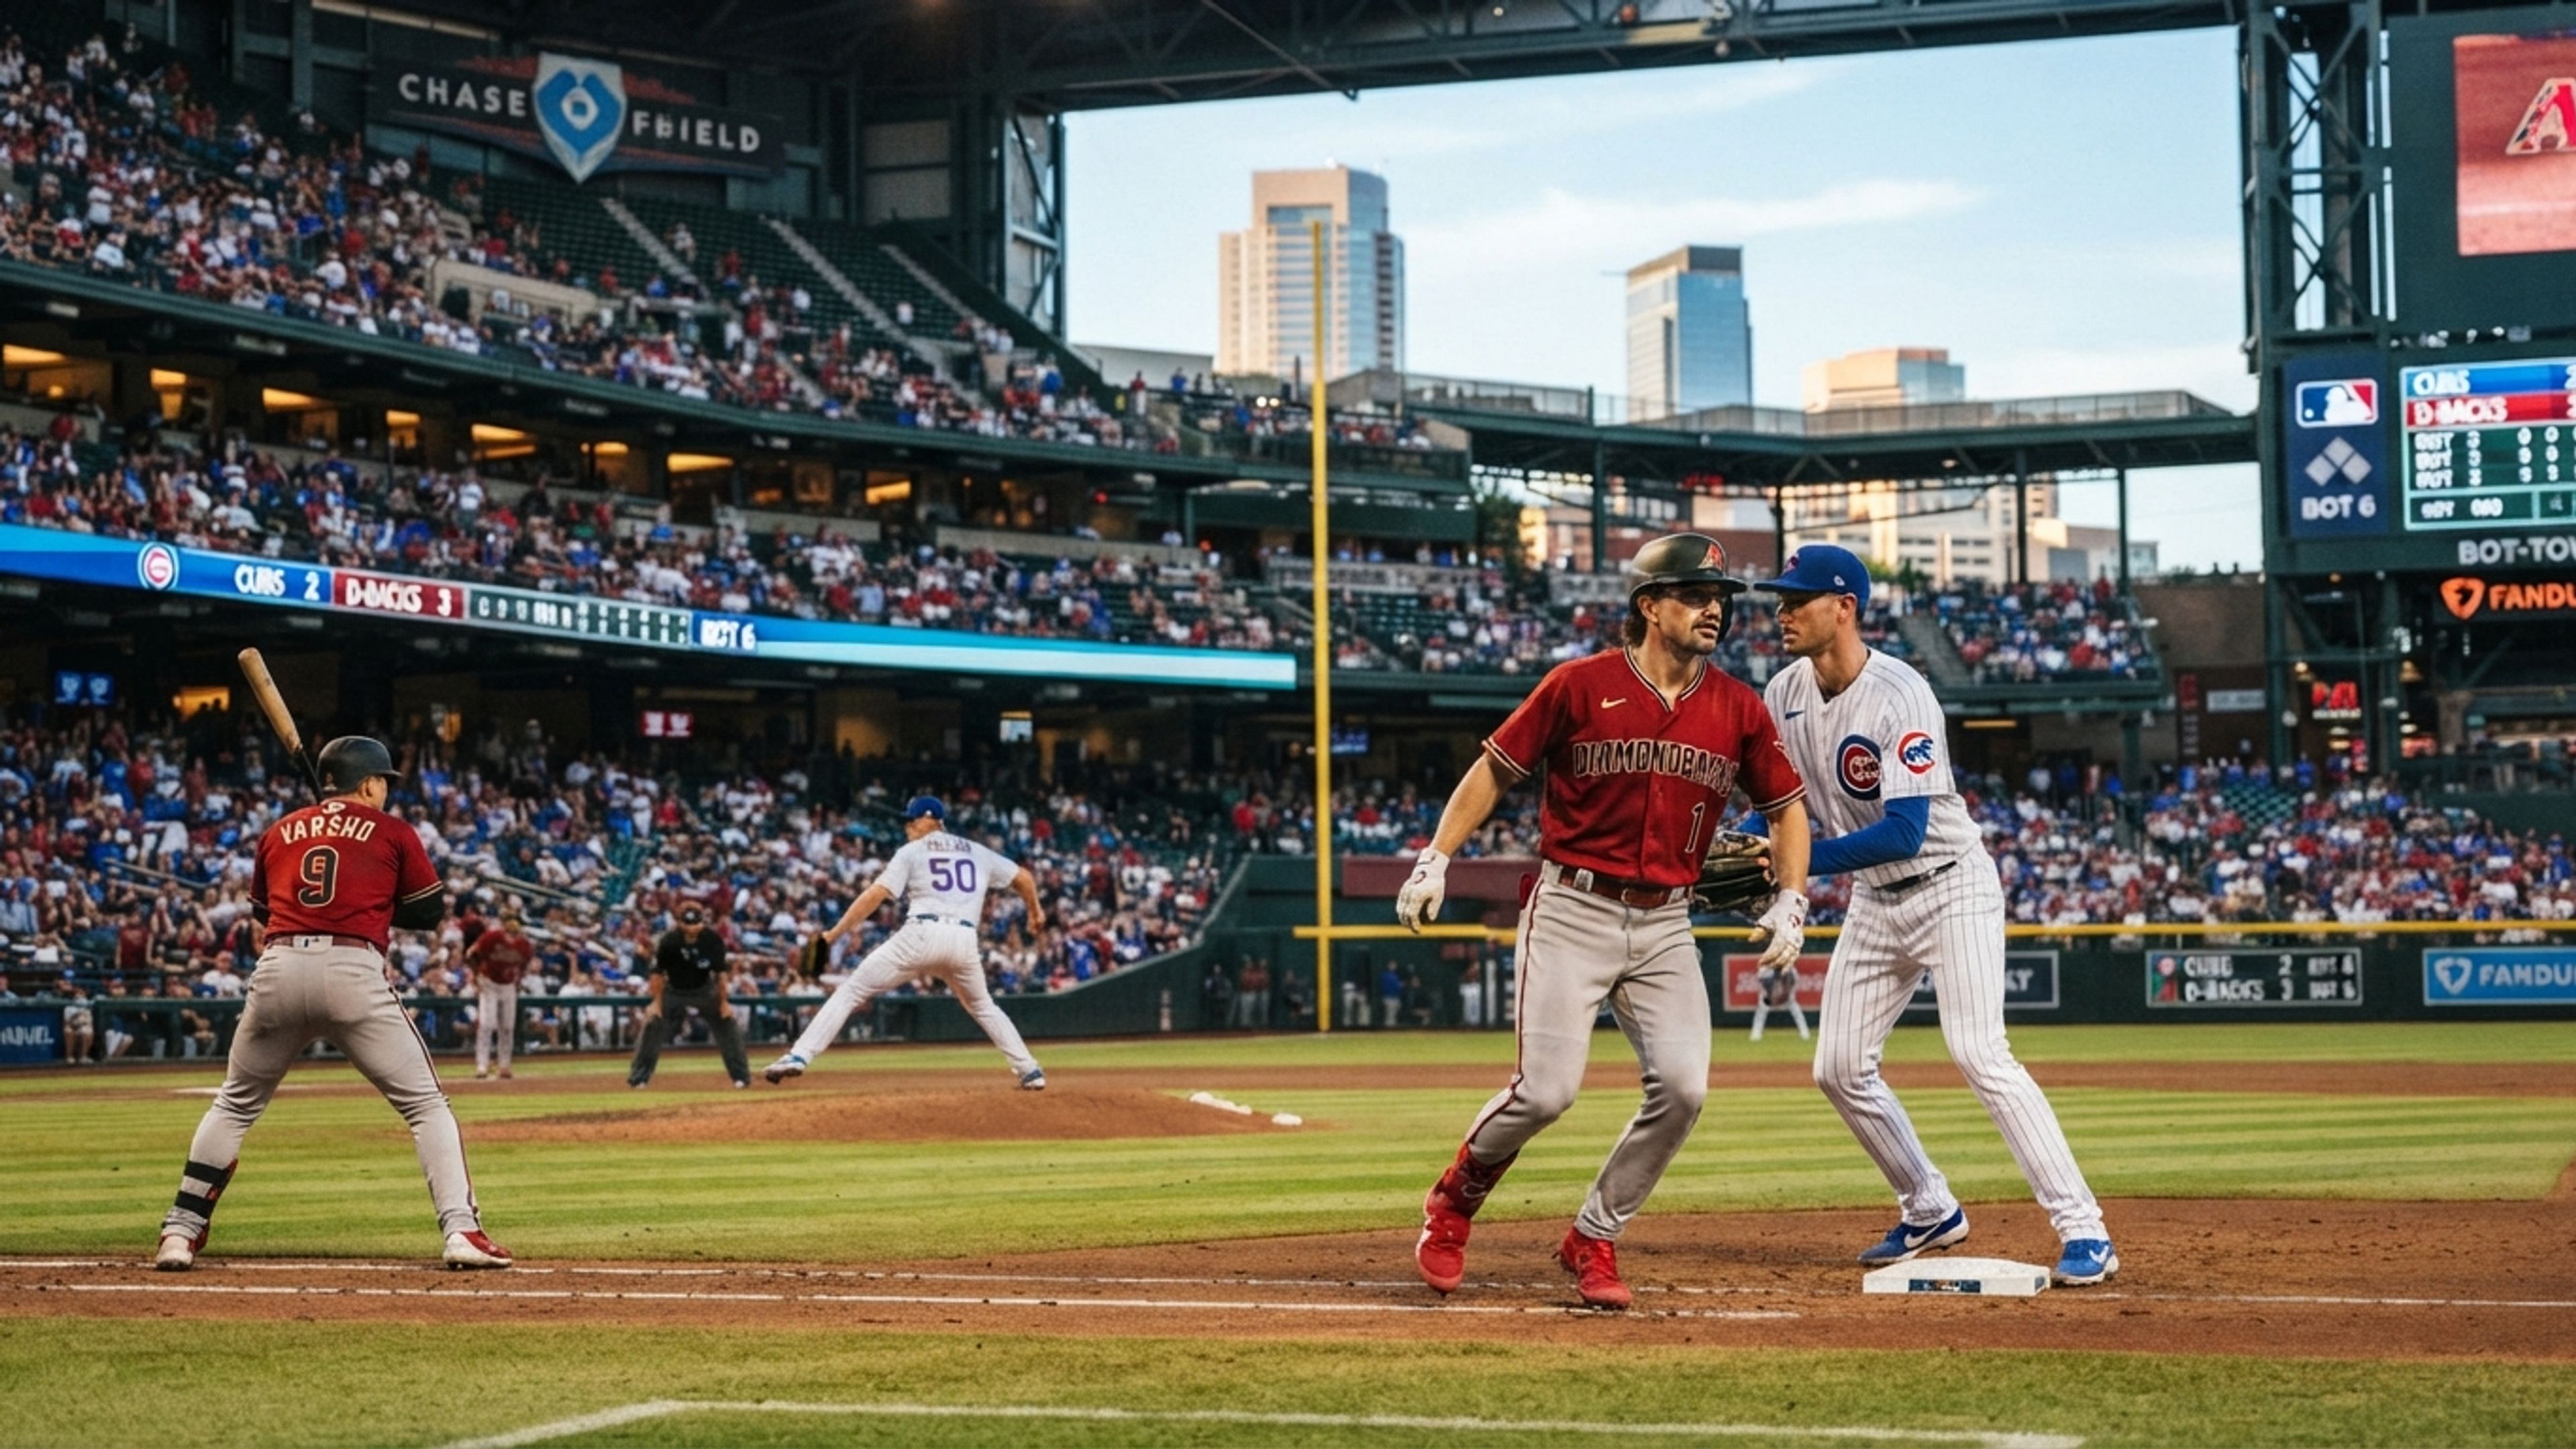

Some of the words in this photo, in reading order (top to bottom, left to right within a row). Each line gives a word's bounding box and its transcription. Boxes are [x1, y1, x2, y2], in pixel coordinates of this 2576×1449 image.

[398, 73, 526, 117] CHASE
[2301, 495, 2354, 520] BOT
[2358, 494, 2377, 518] 6
[304, 571, 320, 601] 2
[741, 623, 756, 650] 6
[280, 815, 376, 845] VARSHO
[1684, 802, 1706, 854] 1
[299, 845, 340, 908] 9
[929, 858, 976, 894] 50
